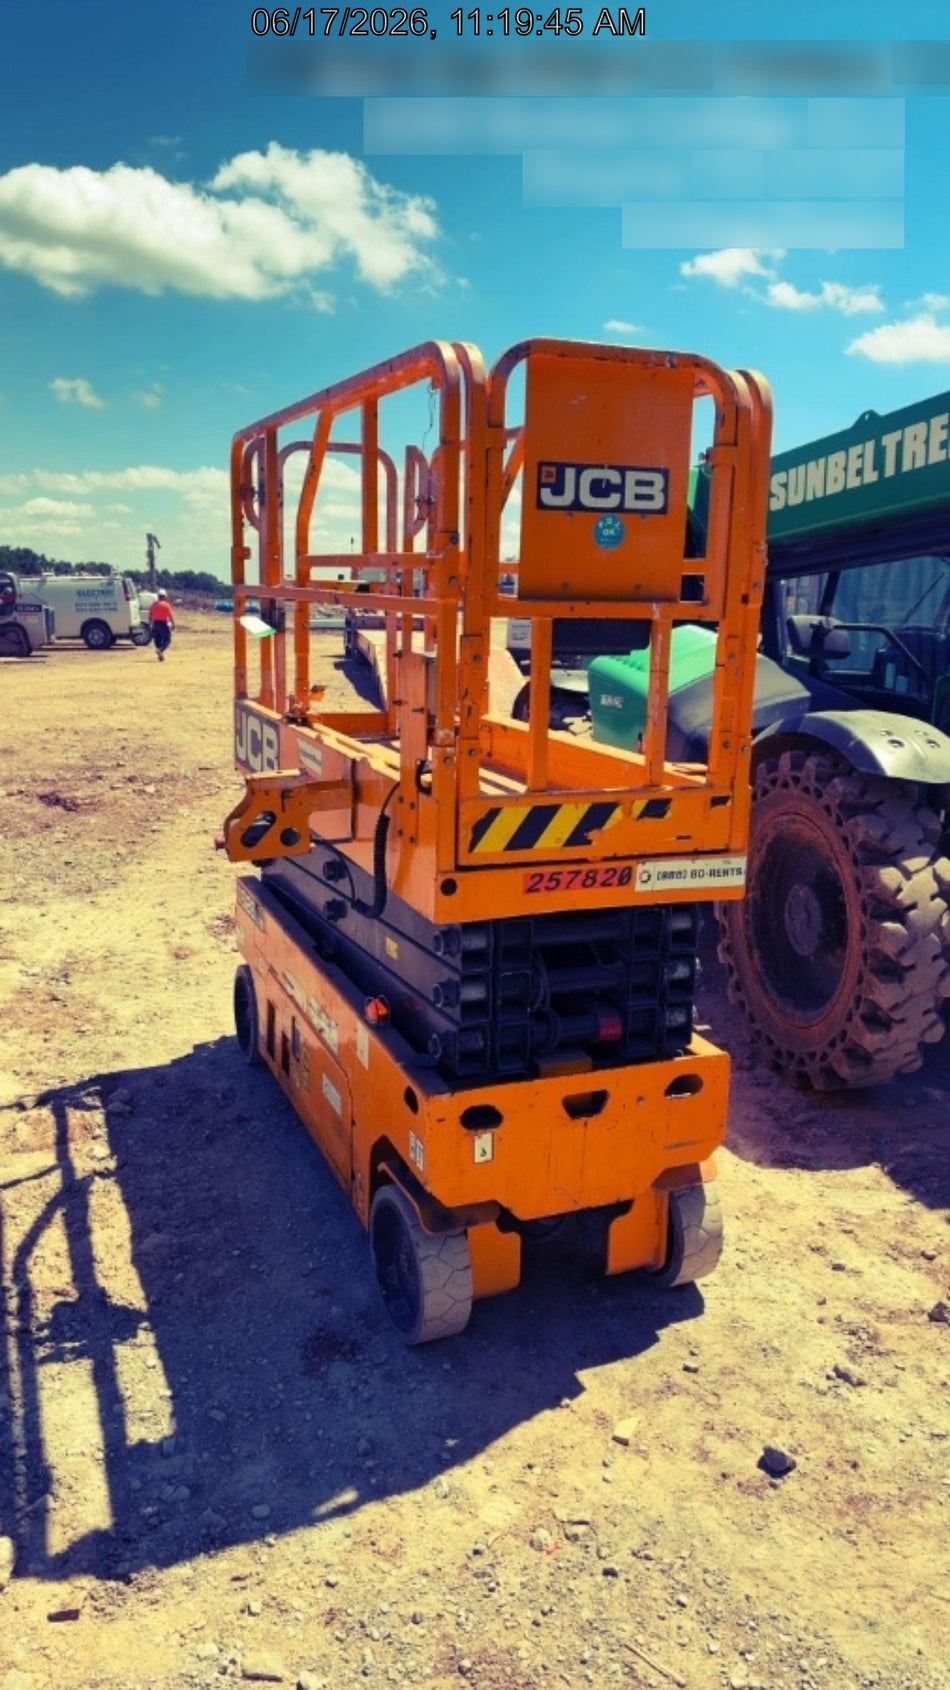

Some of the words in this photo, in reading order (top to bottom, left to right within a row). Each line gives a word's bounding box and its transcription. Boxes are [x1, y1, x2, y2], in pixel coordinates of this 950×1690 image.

[540, 466, 665, 510] JCB
[236, 710, 279, 772] JCB
[525, 866, 633, 893] 257820
